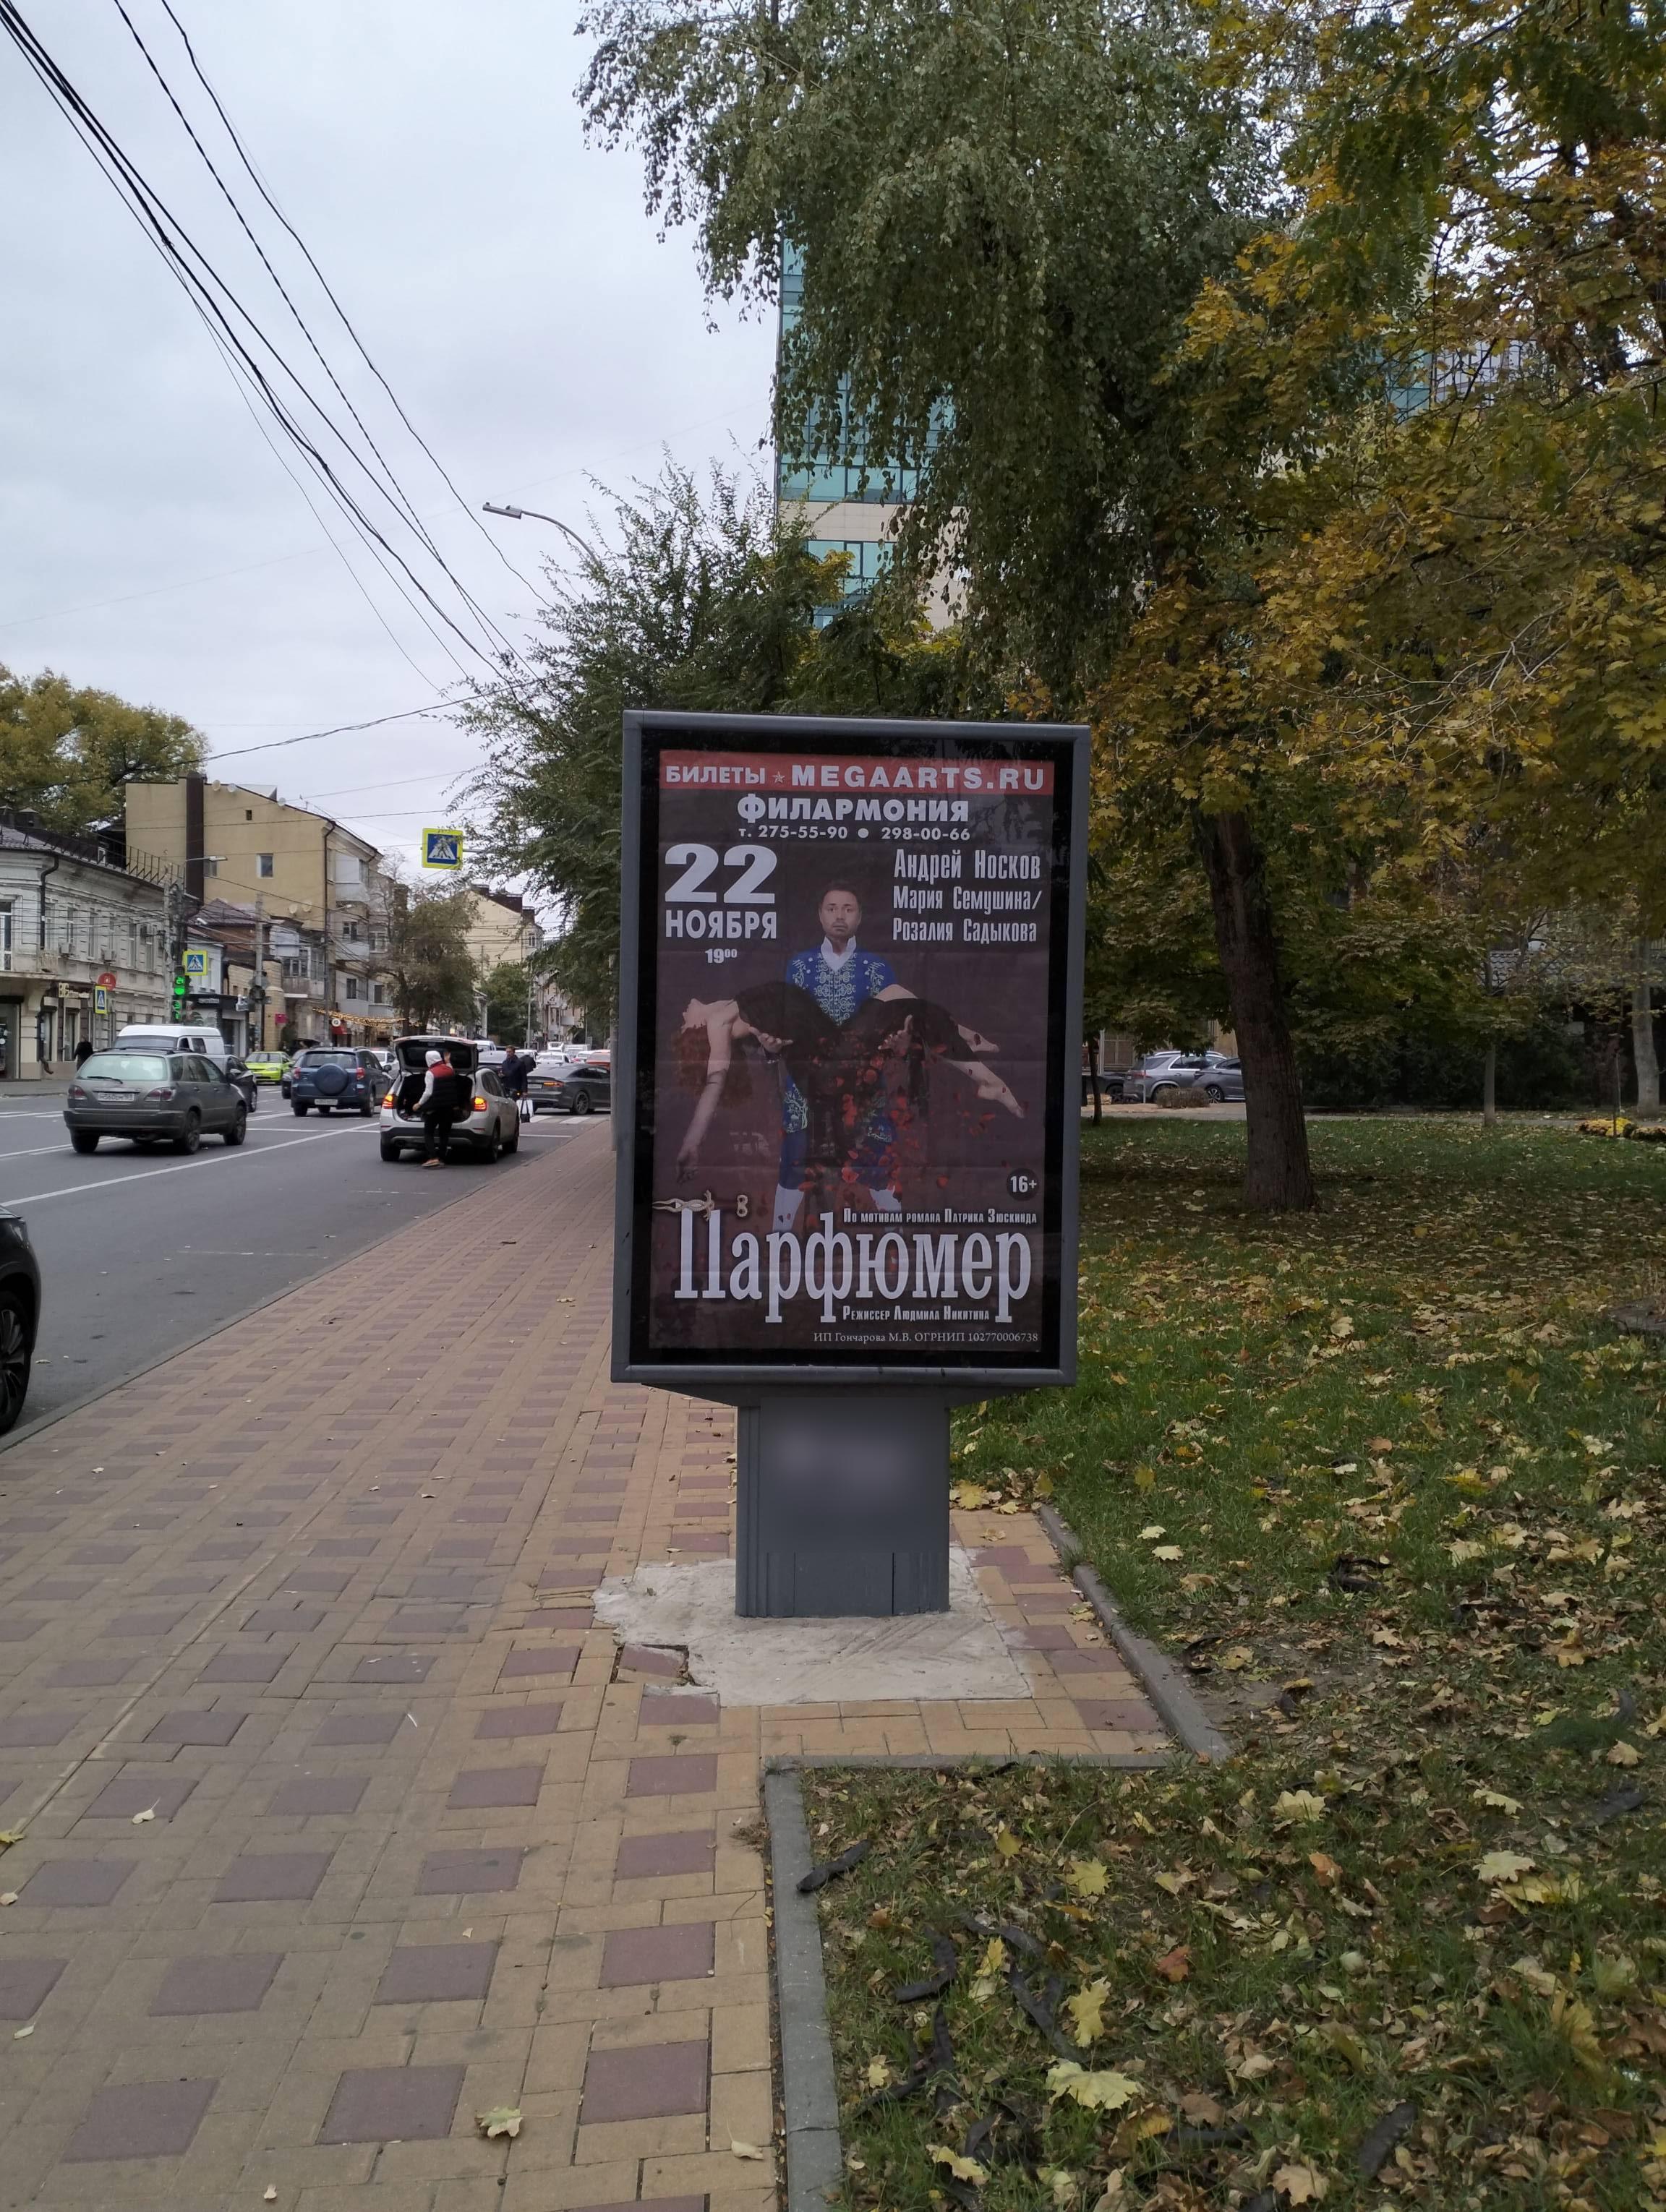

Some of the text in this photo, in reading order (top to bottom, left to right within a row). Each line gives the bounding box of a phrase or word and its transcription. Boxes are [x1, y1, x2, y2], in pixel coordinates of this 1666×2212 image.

[665, 766, 765, 784] БИЛЕТЫ
[792, 765, 1043, 790] MEGAARTS.RU
[737, 793, 969, 823] ФИЛАРМОНИЯ
[758, 826, 848, 839] 275-55-90
[881, 827, 970, 841] 298-00-66
[665, 843, 777, 904] 22
[894, 849, 1041, 885] Андрей Носков
[893, 886, 943, 914] Мария
[665, 909, 777, 939] НОЯБРЯ
[893, 917, 1037, 944] Розалия Садыкова
[1010, 1175, 1037, 1193] 16+
[674, 1200, 1032, 1323] Парфюмер
[813, 1332, 1038, 1345] ИП Гончарова М.В. ОГРНИП 102770006738
